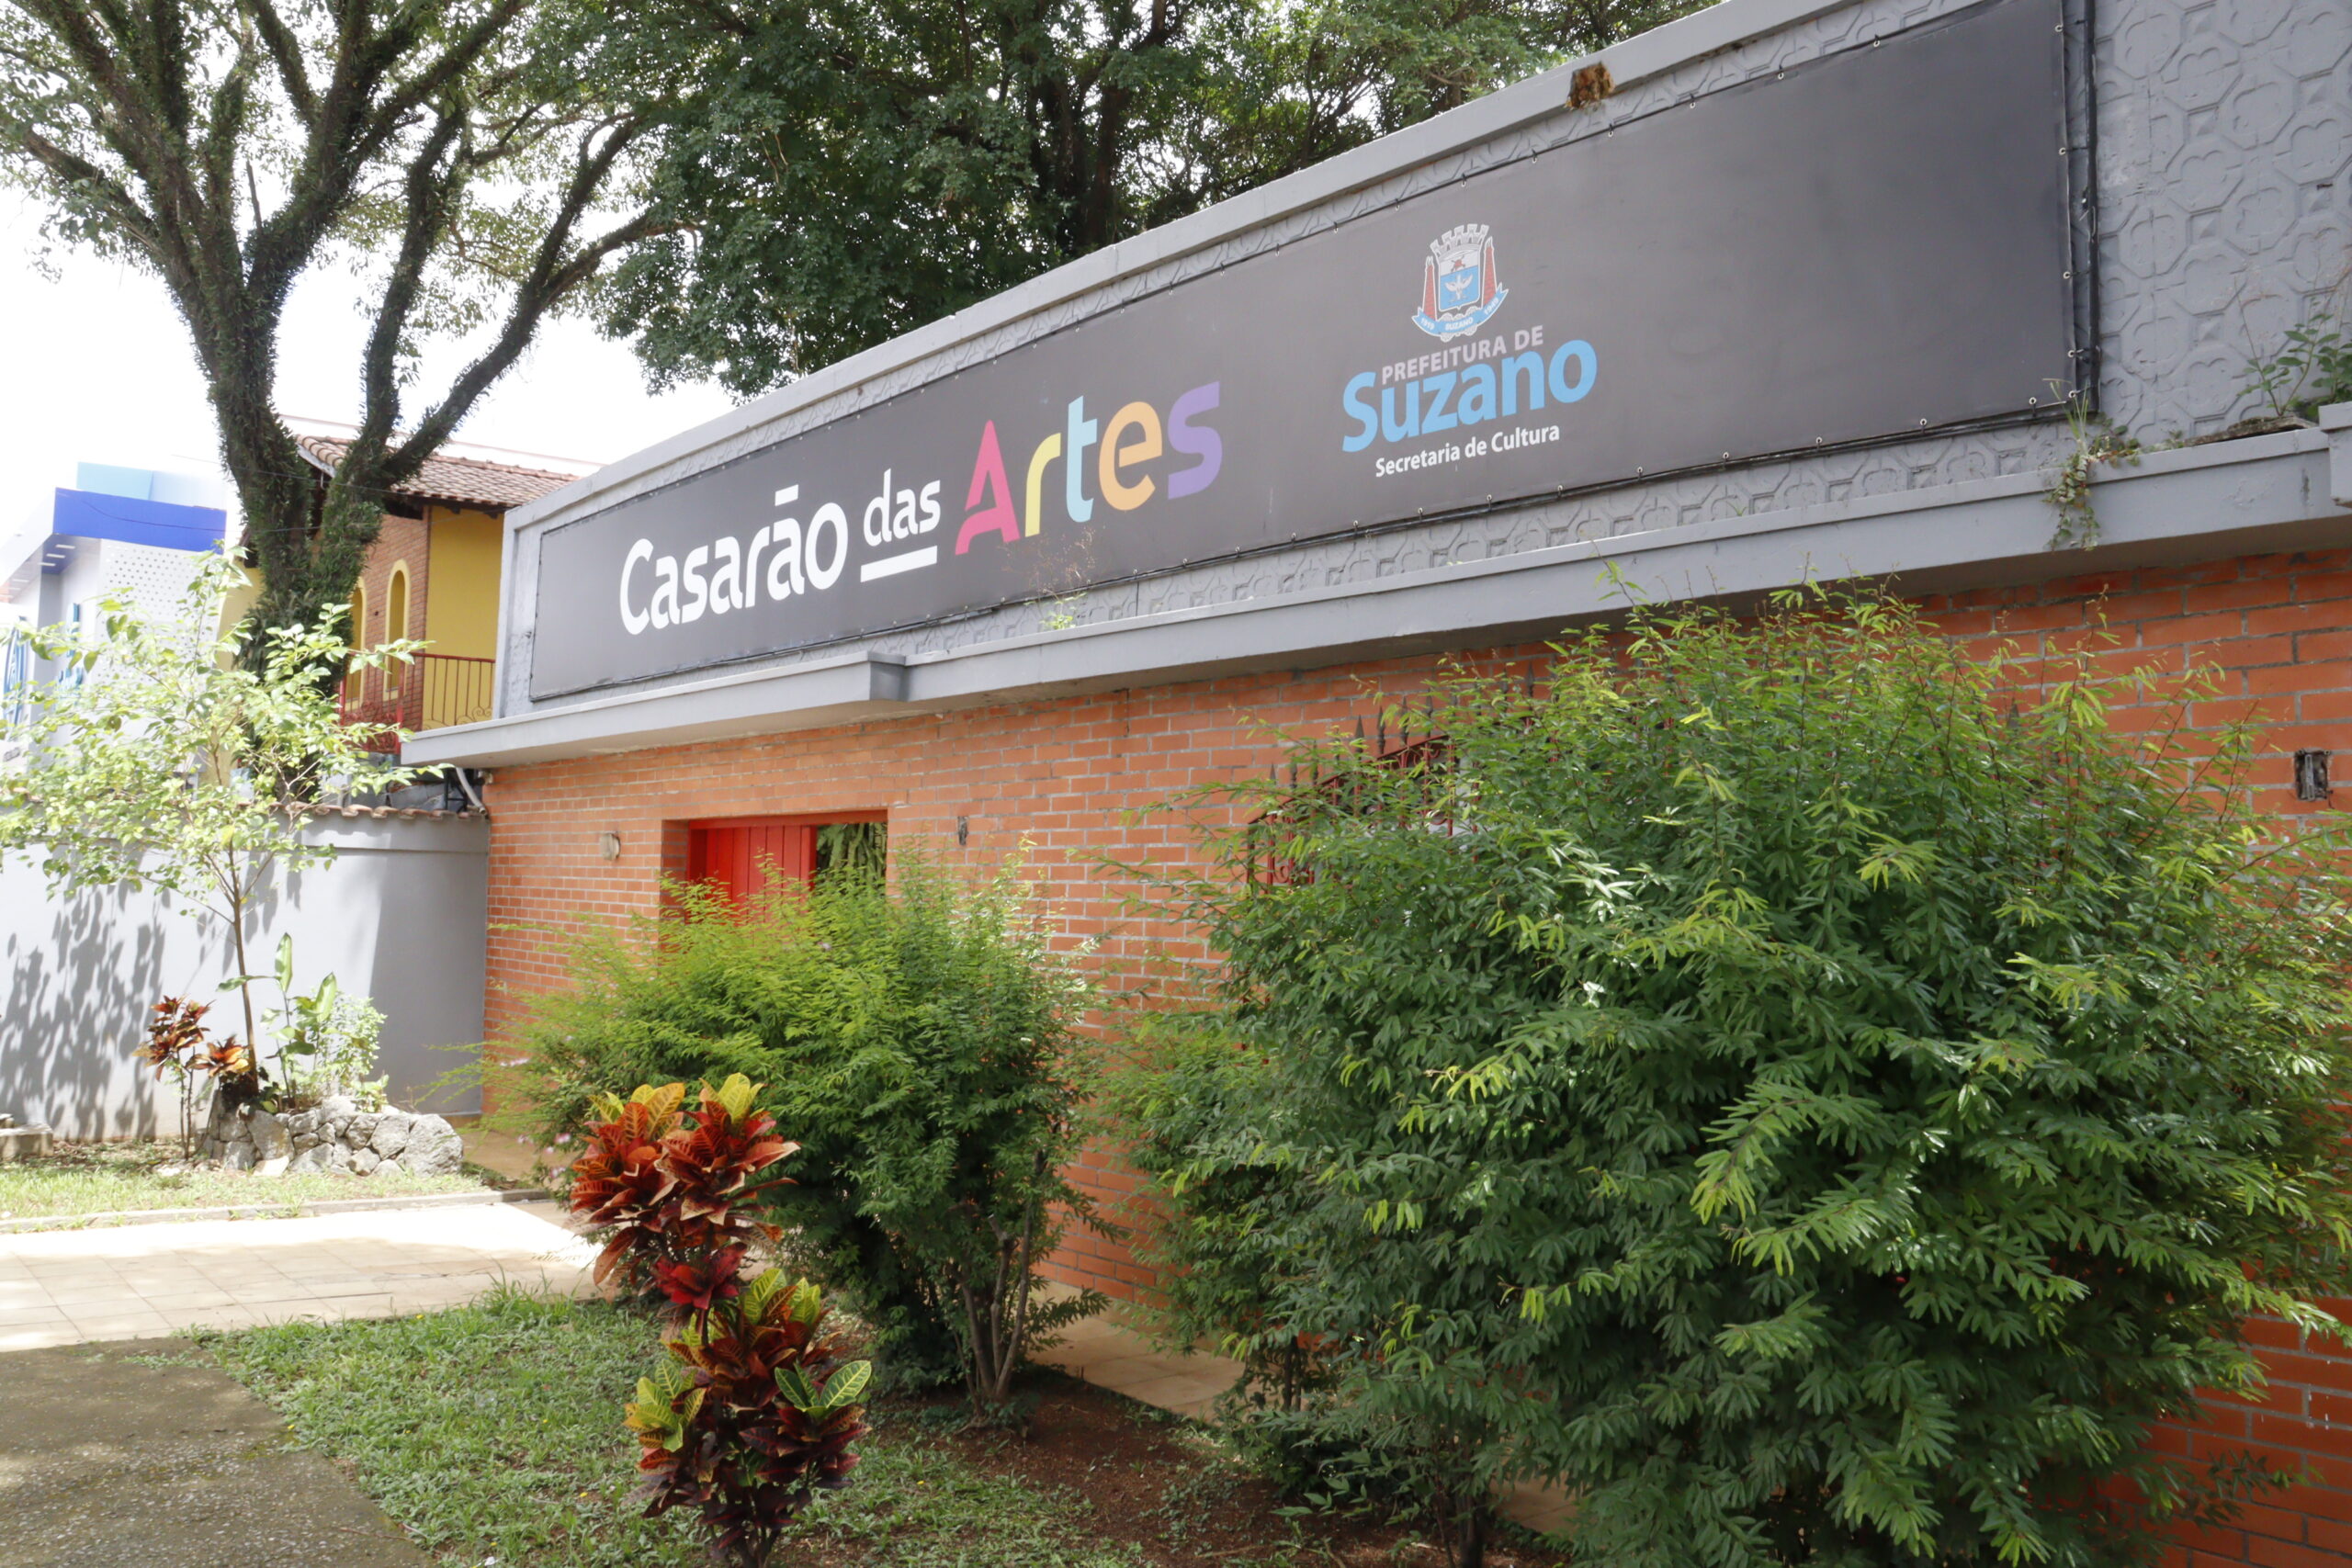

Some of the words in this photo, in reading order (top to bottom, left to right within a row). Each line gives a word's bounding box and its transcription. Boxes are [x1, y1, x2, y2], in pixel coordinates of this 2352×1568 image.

[1445, 317, 1474, 331] SUZANO
[1382, 335, 1507, 384] PREFEITURA
[1514, 325, 1544, 351] DE
[1342, 339, 1597, 452] Suzano
[1375, 444, 1460, 477] Secretaria
[1464, 436, 1487, 458] de
[1491, 424, 1560, 452] Cultura
[619, 484, 848, 635] Casarão
[862, 468, 941, 547] das
[955, 381, 1223, 554] Artes
